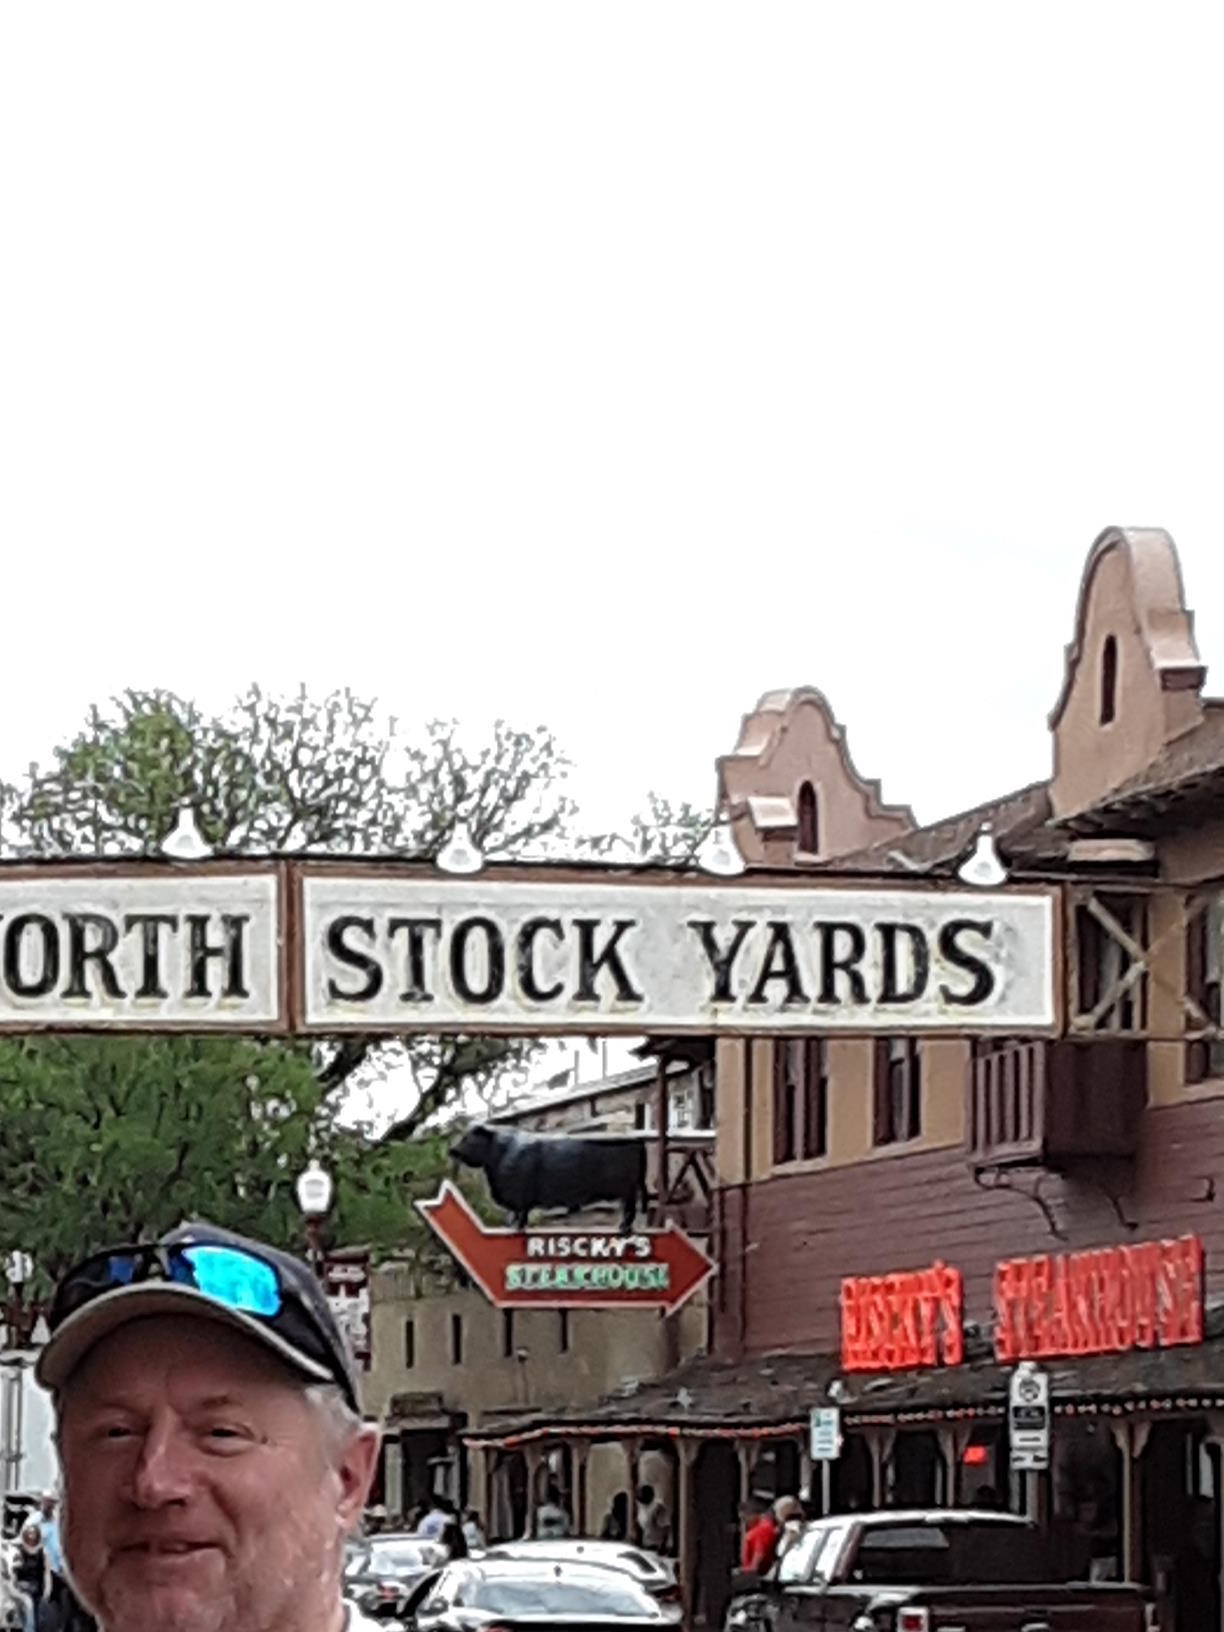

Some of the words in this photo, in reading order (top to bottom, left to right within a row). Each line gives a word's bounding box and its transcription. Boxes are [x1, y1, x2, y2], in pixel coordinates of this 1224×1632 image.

[325, 914, 644, 1004] STOCK
[687, 917, 997, 1007] YARDS
[526, 1234, 652, 1258] RISCKY'S
[504, 1262, 670, 1291] STEAKHOUSE
